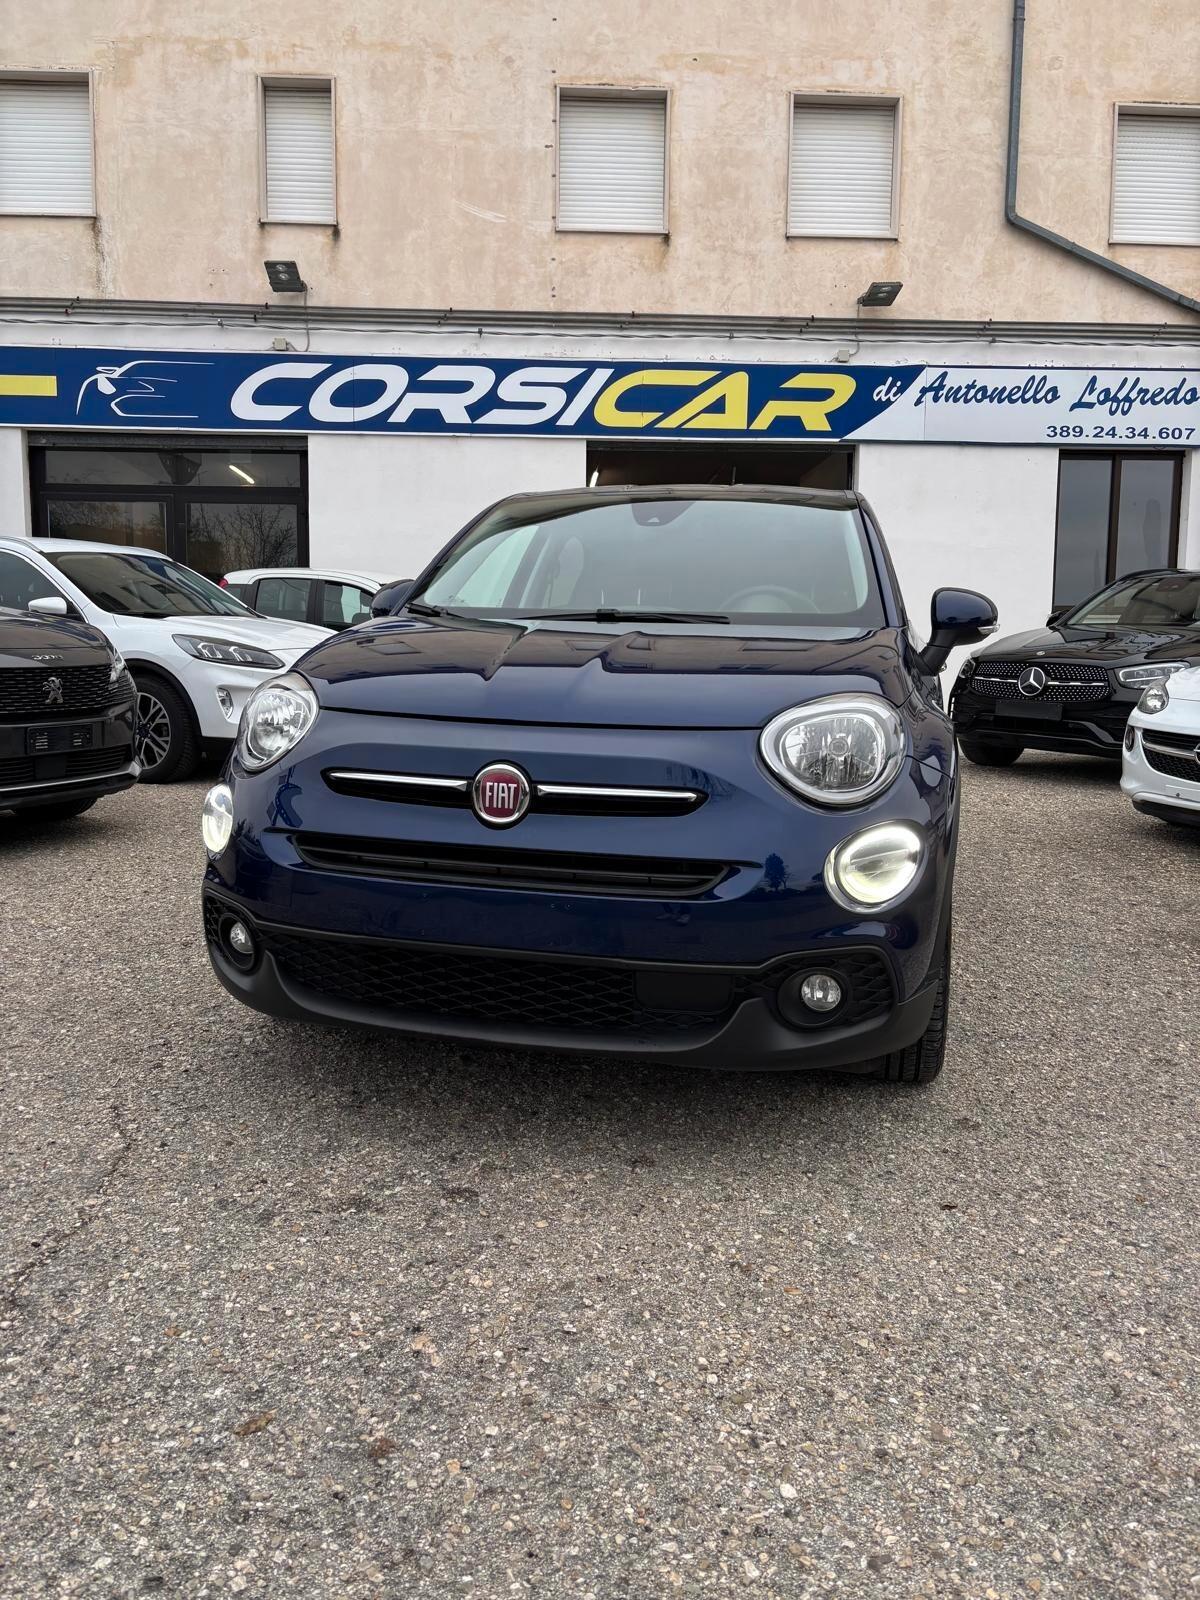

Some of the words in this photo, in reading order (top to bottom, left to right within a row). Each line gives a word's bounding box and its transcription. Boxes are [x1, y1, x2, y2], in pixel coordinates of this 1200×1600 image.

[230, 363, 856, 431] CORSICAR
[873, 376, 902, 402] di
[913, 371, 1061, 407] Antonello
[1069, 375, 1200, 416] Loffredo
[1046, 425, 1196, 440] 389.24.34.607
[485, 782, 517, 809] FIAT
